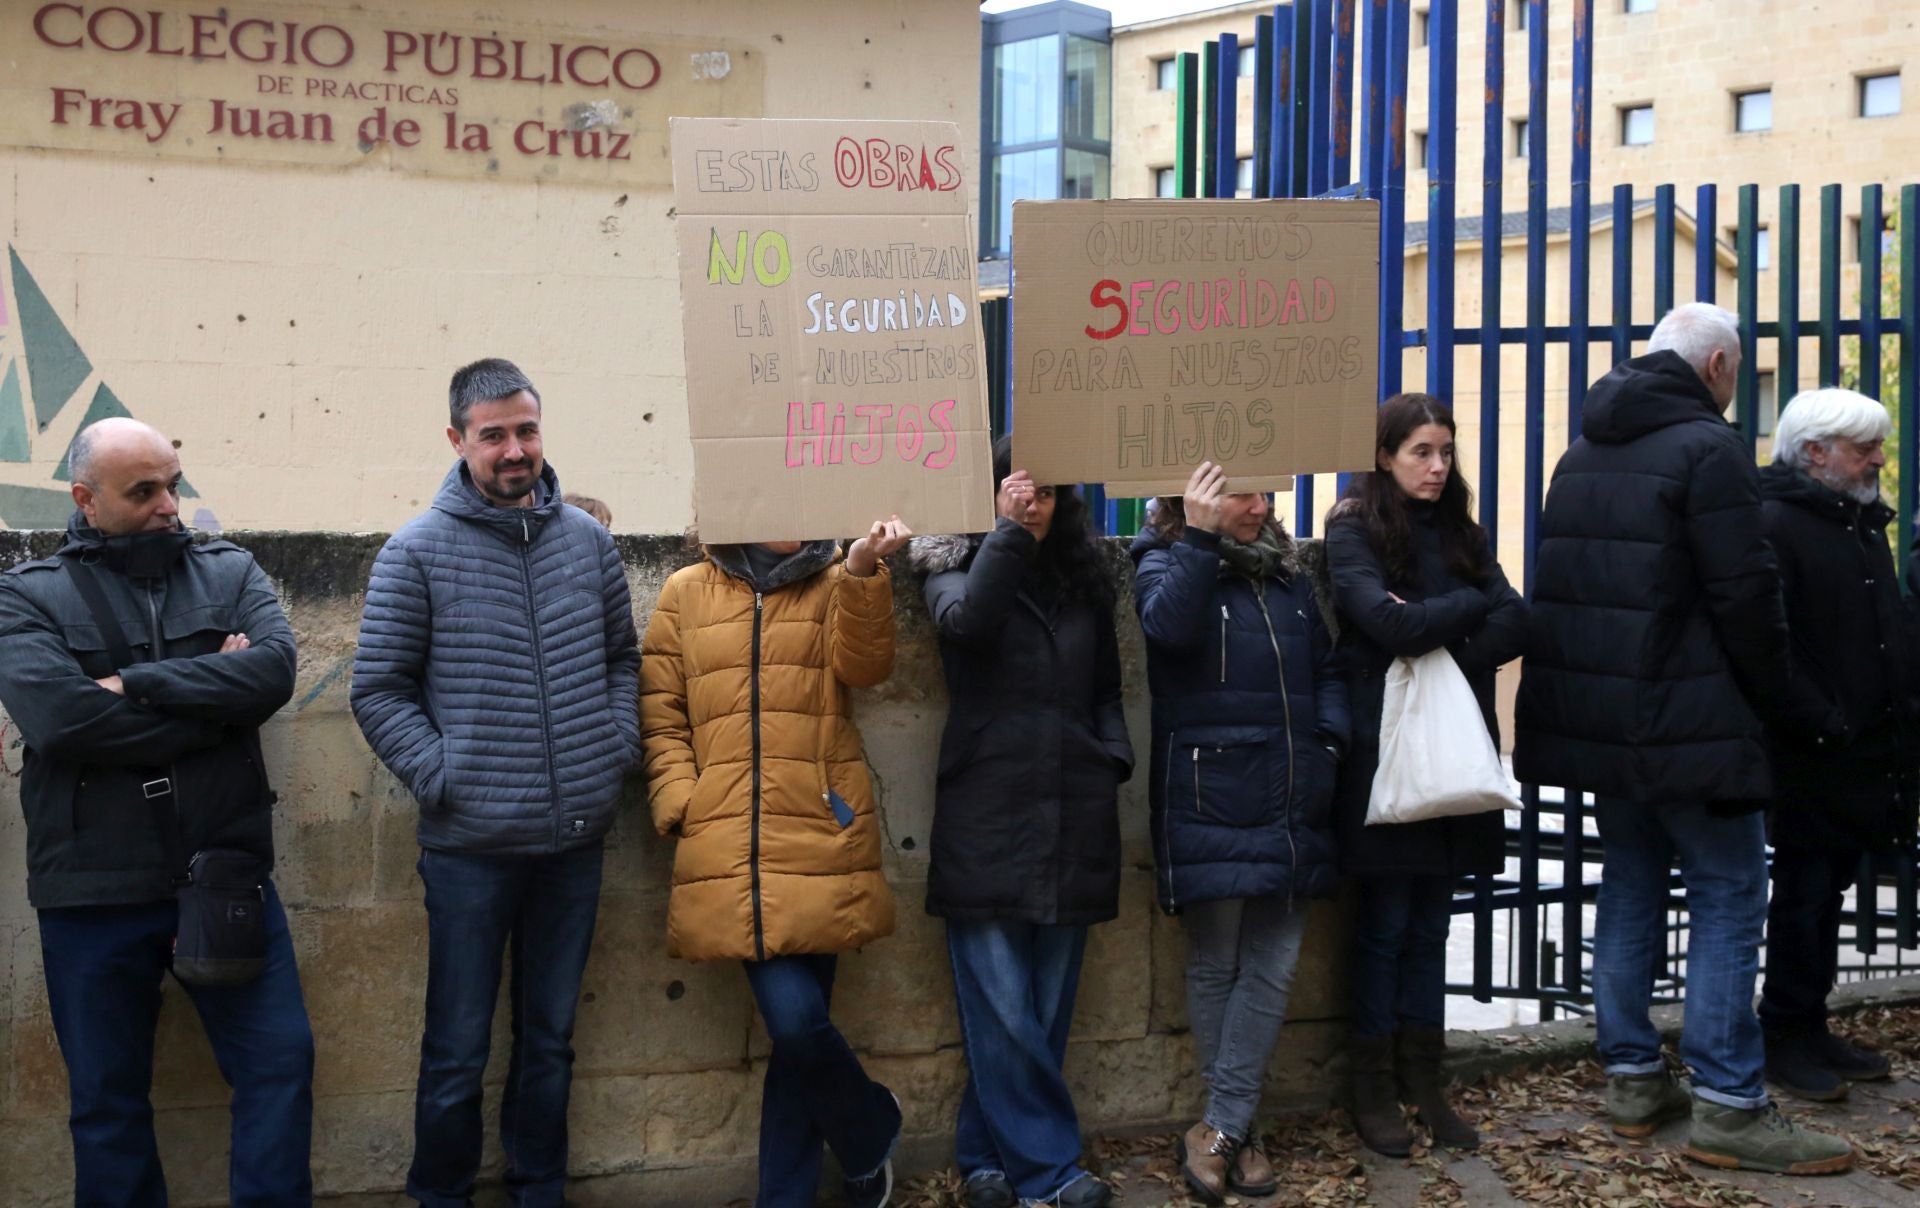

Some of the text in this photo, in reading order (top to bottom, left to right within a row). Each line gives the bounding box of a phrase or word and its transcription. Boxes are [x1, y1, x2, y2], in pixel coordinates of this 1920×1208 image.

[33, 3, 662, 91] COLEGIO PÚBLICO
[257, 74, 460, 106] DE PRACTICAS
[50, 87, 632, 161] Fray Juan de la Cruz
[696, 136, 962, 193] ESTAS OBRAS
[707, 226, 792, 287] NO
[1085, 213, 1313, 267] QUEREMOS
[734, 300, 774, 338] LA
[750, 339, 976, 387] DE NUESTROS
[1029, 335, 1363, 394] PARA NUESTROS
